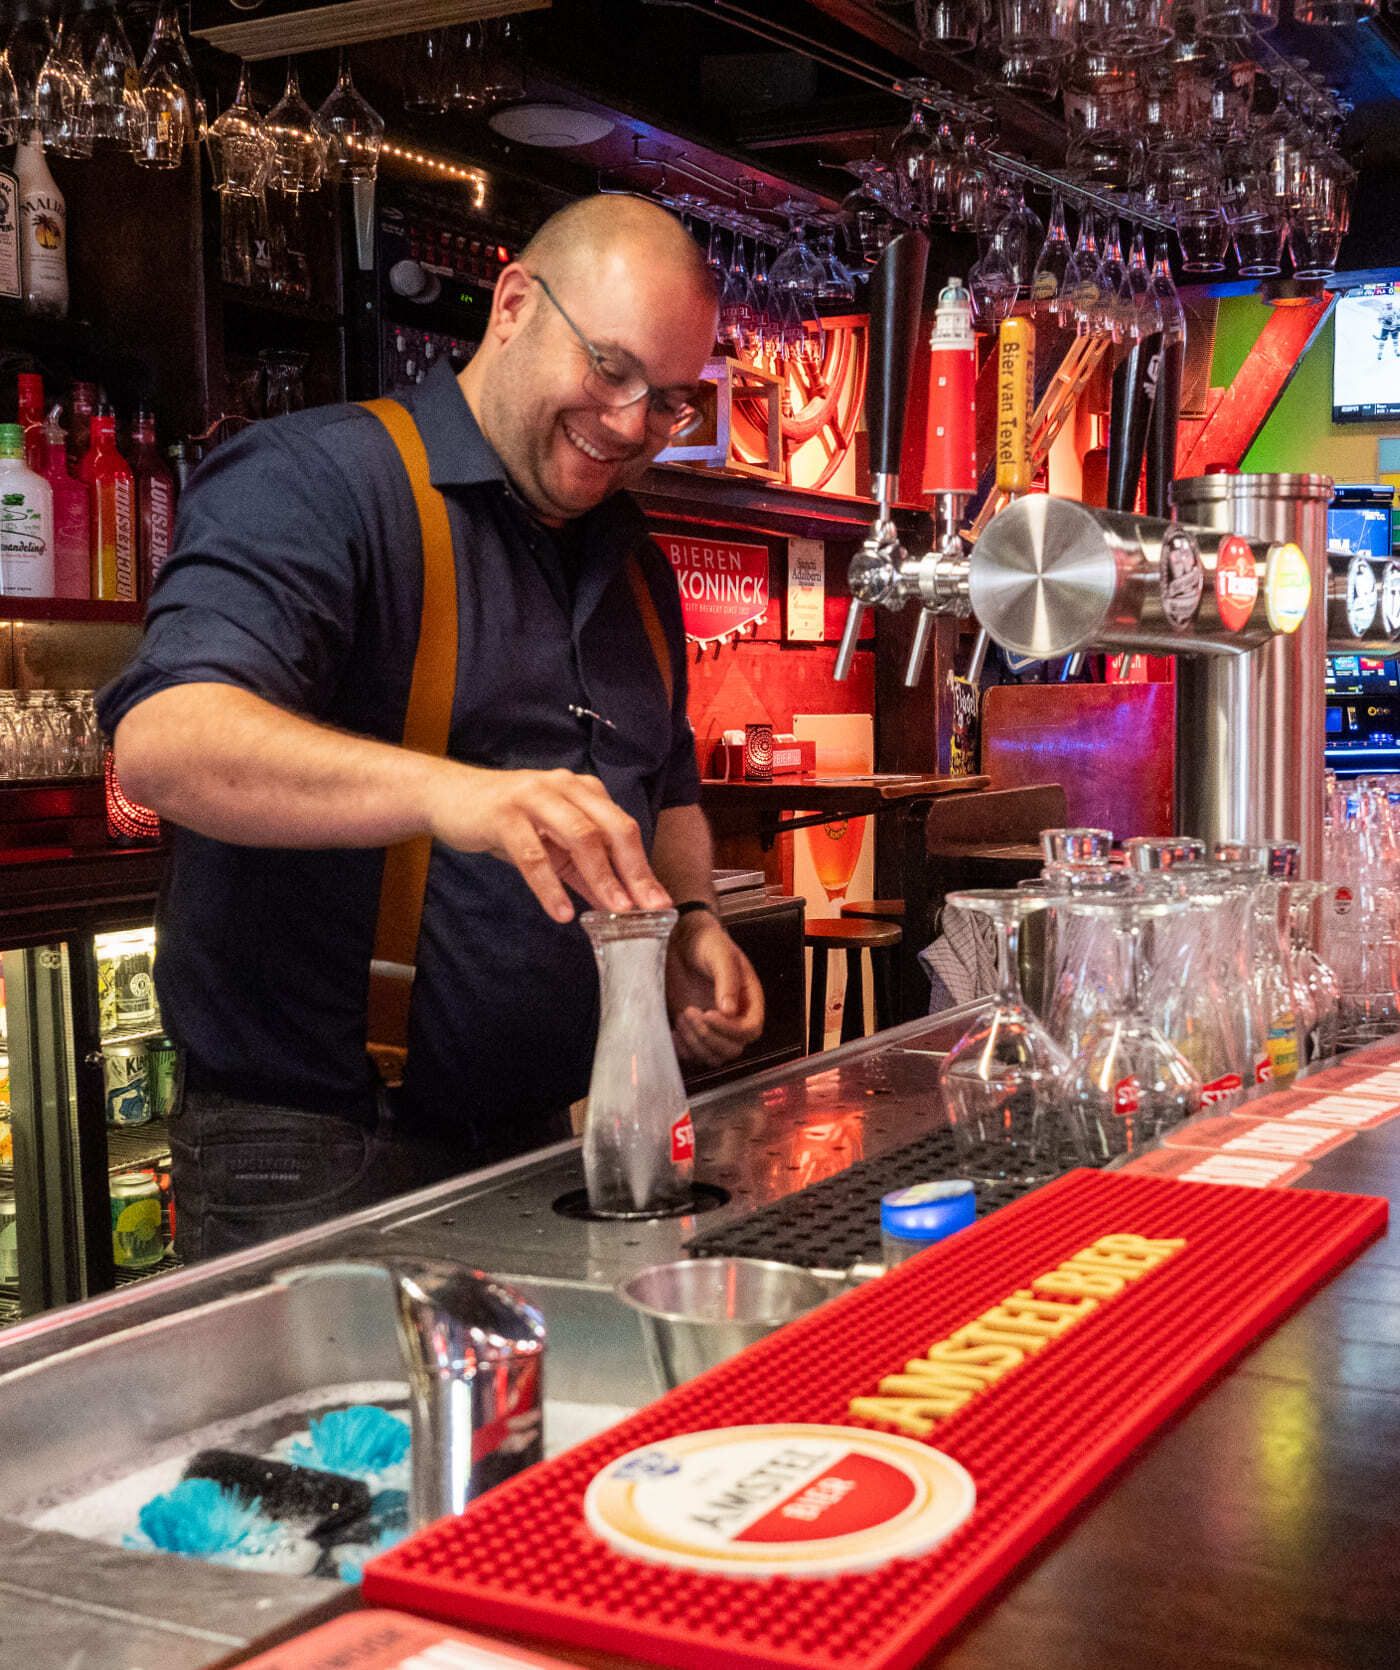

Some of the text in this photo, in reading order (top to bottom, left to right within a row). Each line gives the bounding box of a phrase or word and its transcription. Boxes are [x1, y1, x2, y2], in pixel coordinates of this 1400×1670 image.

[999, 342, 1020, 465] Bier van Texel
[670, 543, 742, 571] BIEREN
[677, 568, 764, 605] KONINCK
[850, 1232, 1187, 1435] AMSTEL BIER
[780, 1476, 858, 1522] BIER
